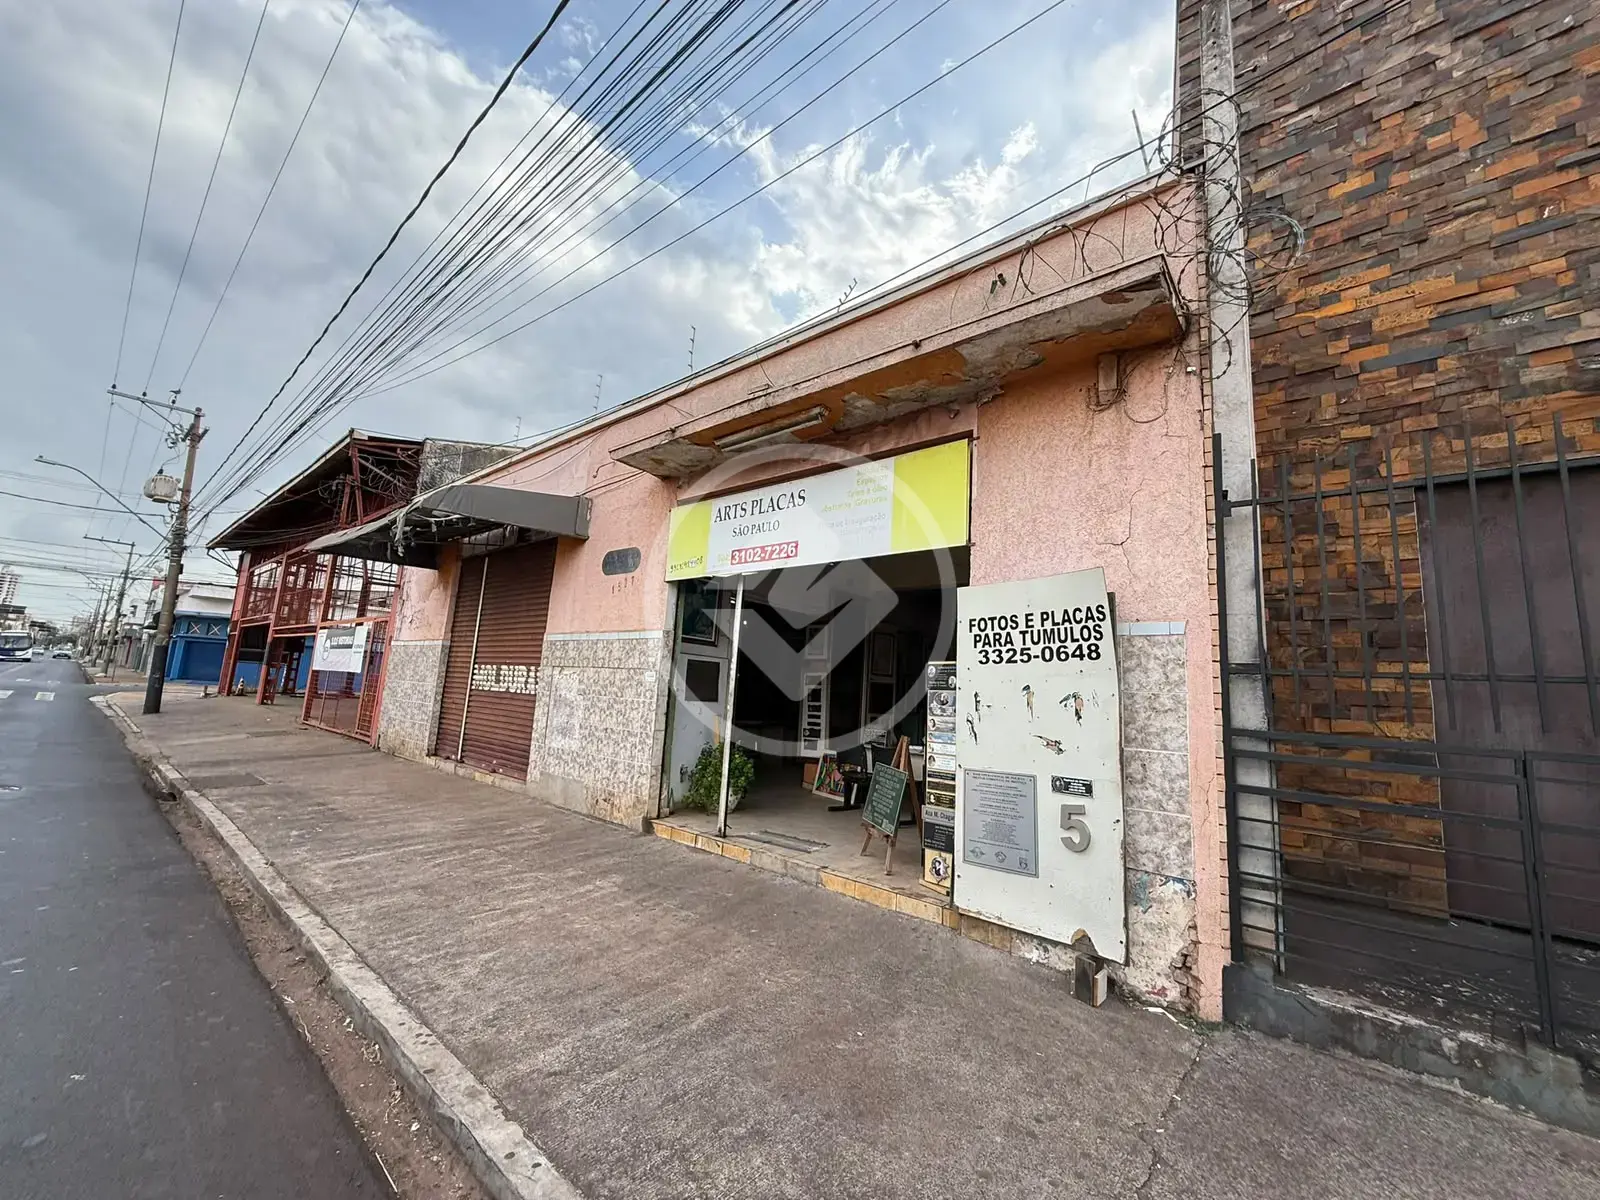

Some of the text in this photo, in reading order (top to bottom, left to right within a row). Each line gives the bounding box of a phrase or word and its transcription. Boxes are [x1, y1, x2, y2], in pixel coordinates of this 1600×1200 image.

[714, 502, 747, 523] ARTS
[750, 489, 806, 516] PLACAS
[732, 519, 780, 538] SÃO PAULO
[731, 542, 797, 565] 3102-7226
[968, 604, 1107, 634] FOTOS E PLACAS
[973, 623, 1104, 649] PARA TUMULOS
[977, 642, 1102, 665] 3325-0648
[1060, 804, 1091, 853] 5
